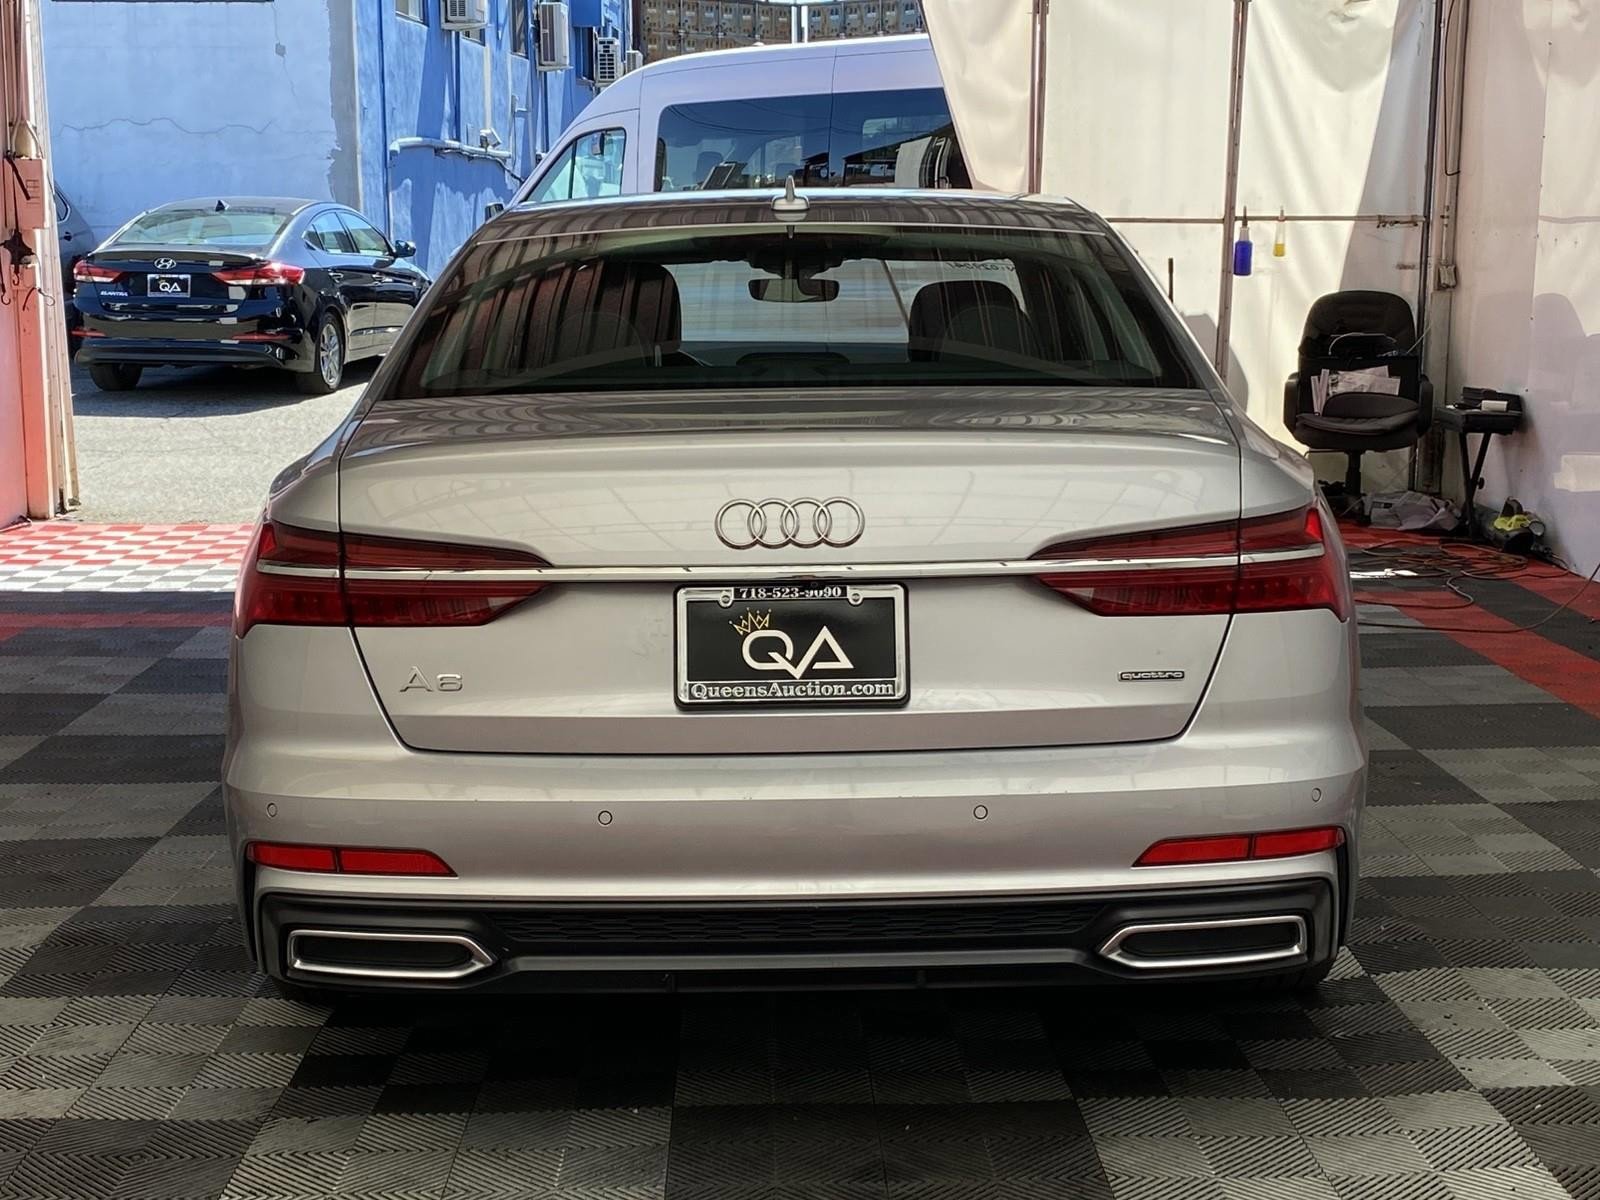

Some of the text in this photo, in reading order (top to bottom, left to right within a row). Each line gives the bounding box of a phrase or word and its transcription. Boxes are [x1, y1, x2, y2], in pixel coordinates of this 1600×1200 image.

[159, 282, 182, 293] QA
[741, 625, 854, 680] QA
[399, 665, 463, 692] A6
[1121, 671, 1183, 680] quattro
[690, 681, 895, 700] QueensAuction.com
